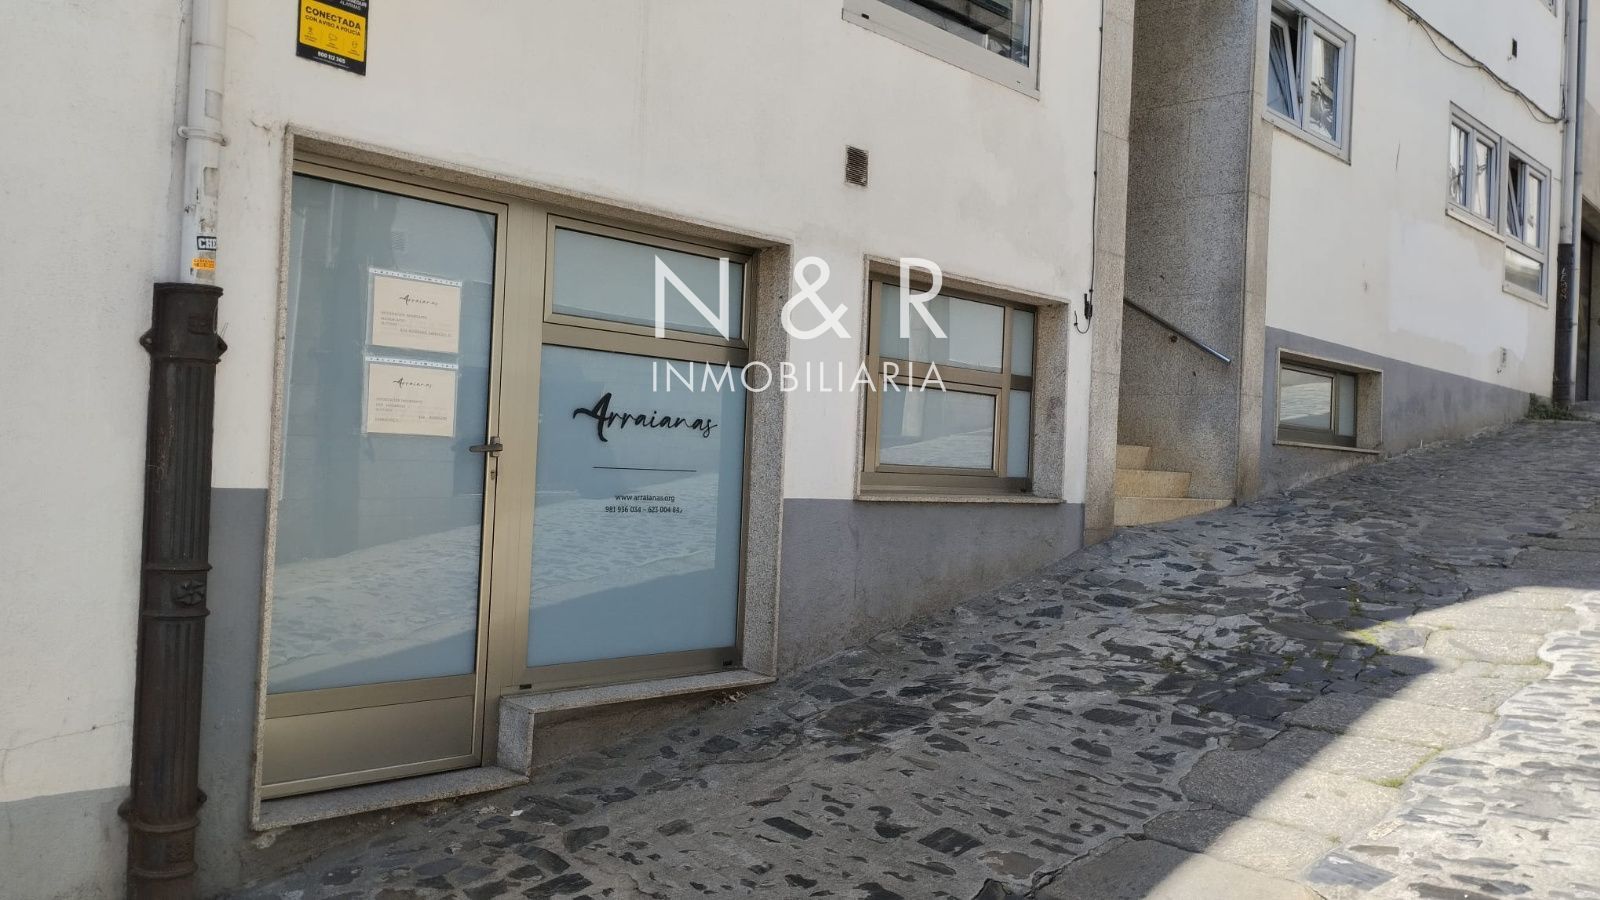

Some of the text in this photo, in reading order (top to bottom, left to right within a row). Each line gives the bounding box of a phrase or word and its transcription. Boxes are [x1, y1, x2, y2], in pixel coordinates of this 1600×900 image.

[305, 6, 361, 30] CONECTADA
[319, 20, 335, 28] AVISO
[572, 392, 718, 443] Arraianas
[614, 494, 676, 503] www.arraianas.org
[659, 505, 671, 513] 004
